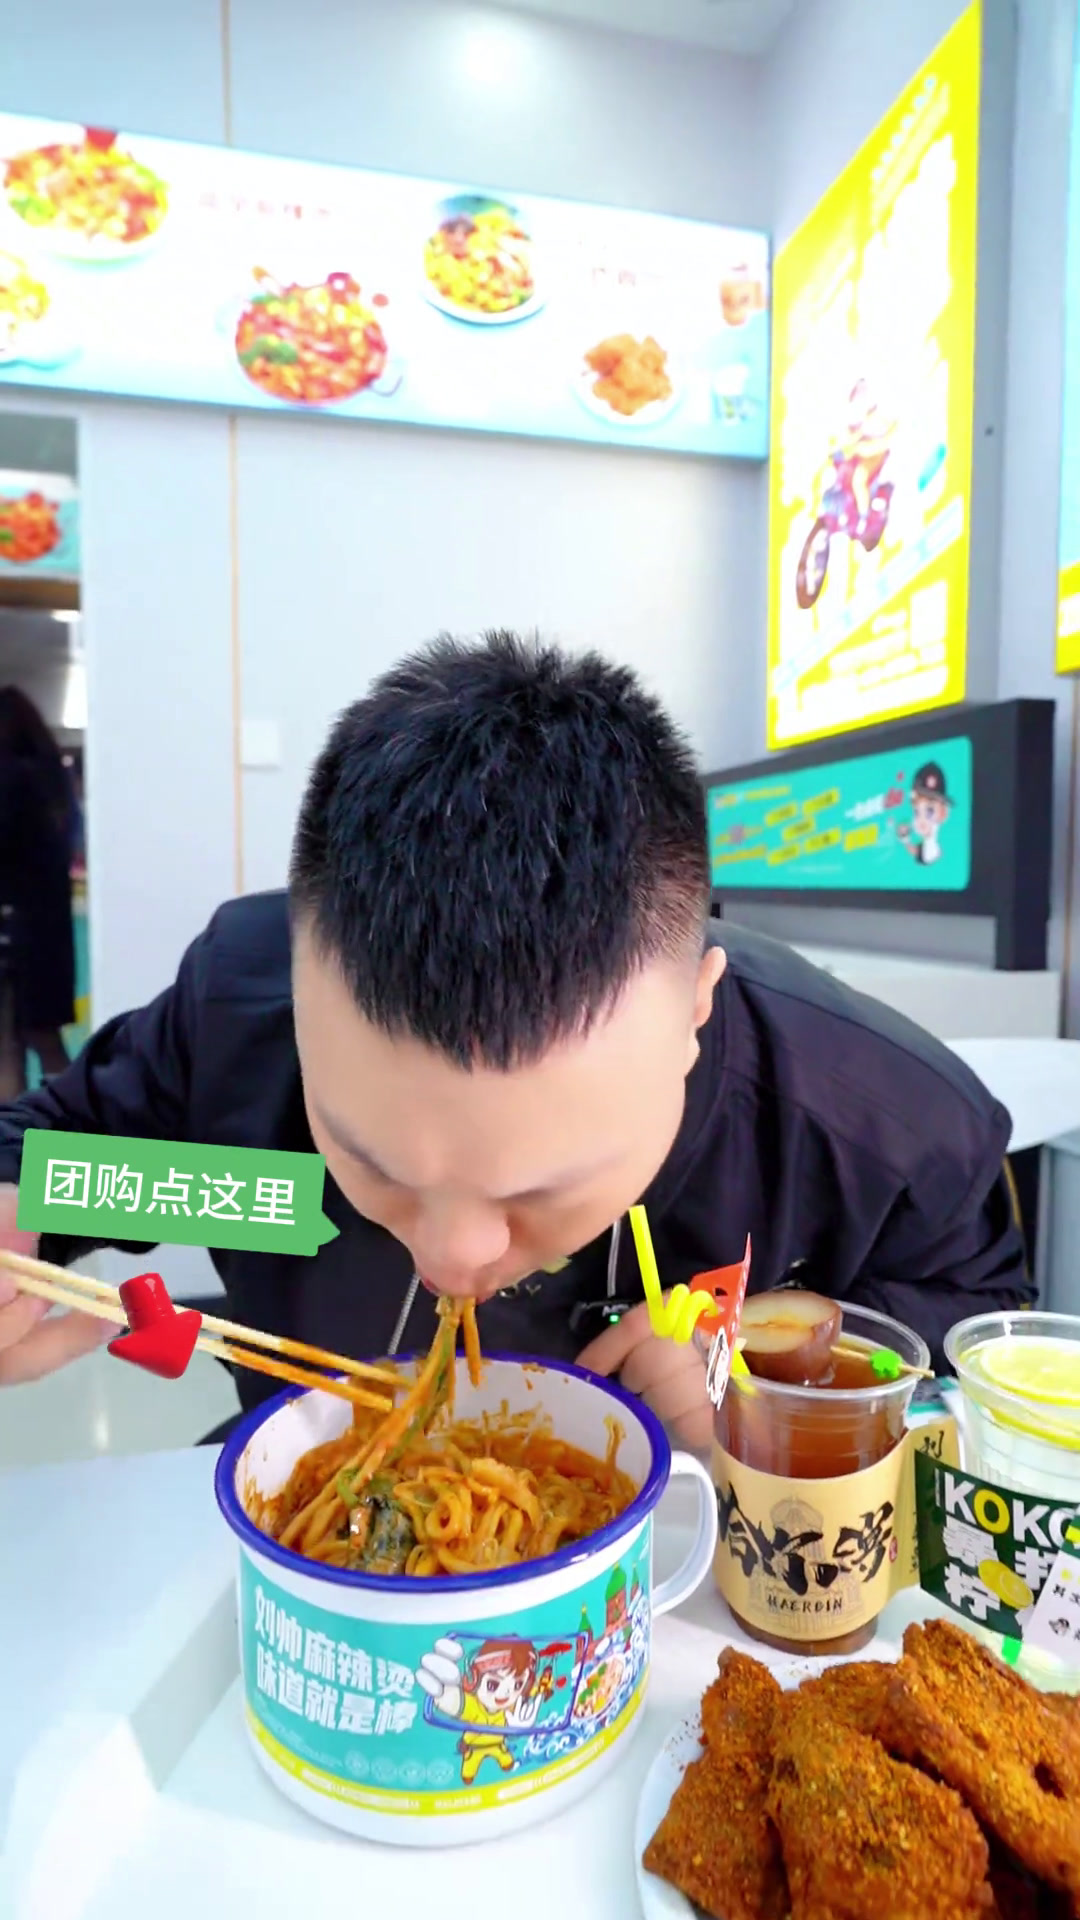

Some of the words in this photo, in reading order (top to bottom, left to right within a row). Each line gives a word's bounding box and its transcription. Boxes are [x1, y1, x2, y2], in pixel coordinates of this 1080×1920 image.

[255, 1584, 415, 1699] 刘帅麻辣烫
[257, 1641, 418, 1736] 味道就是棒
